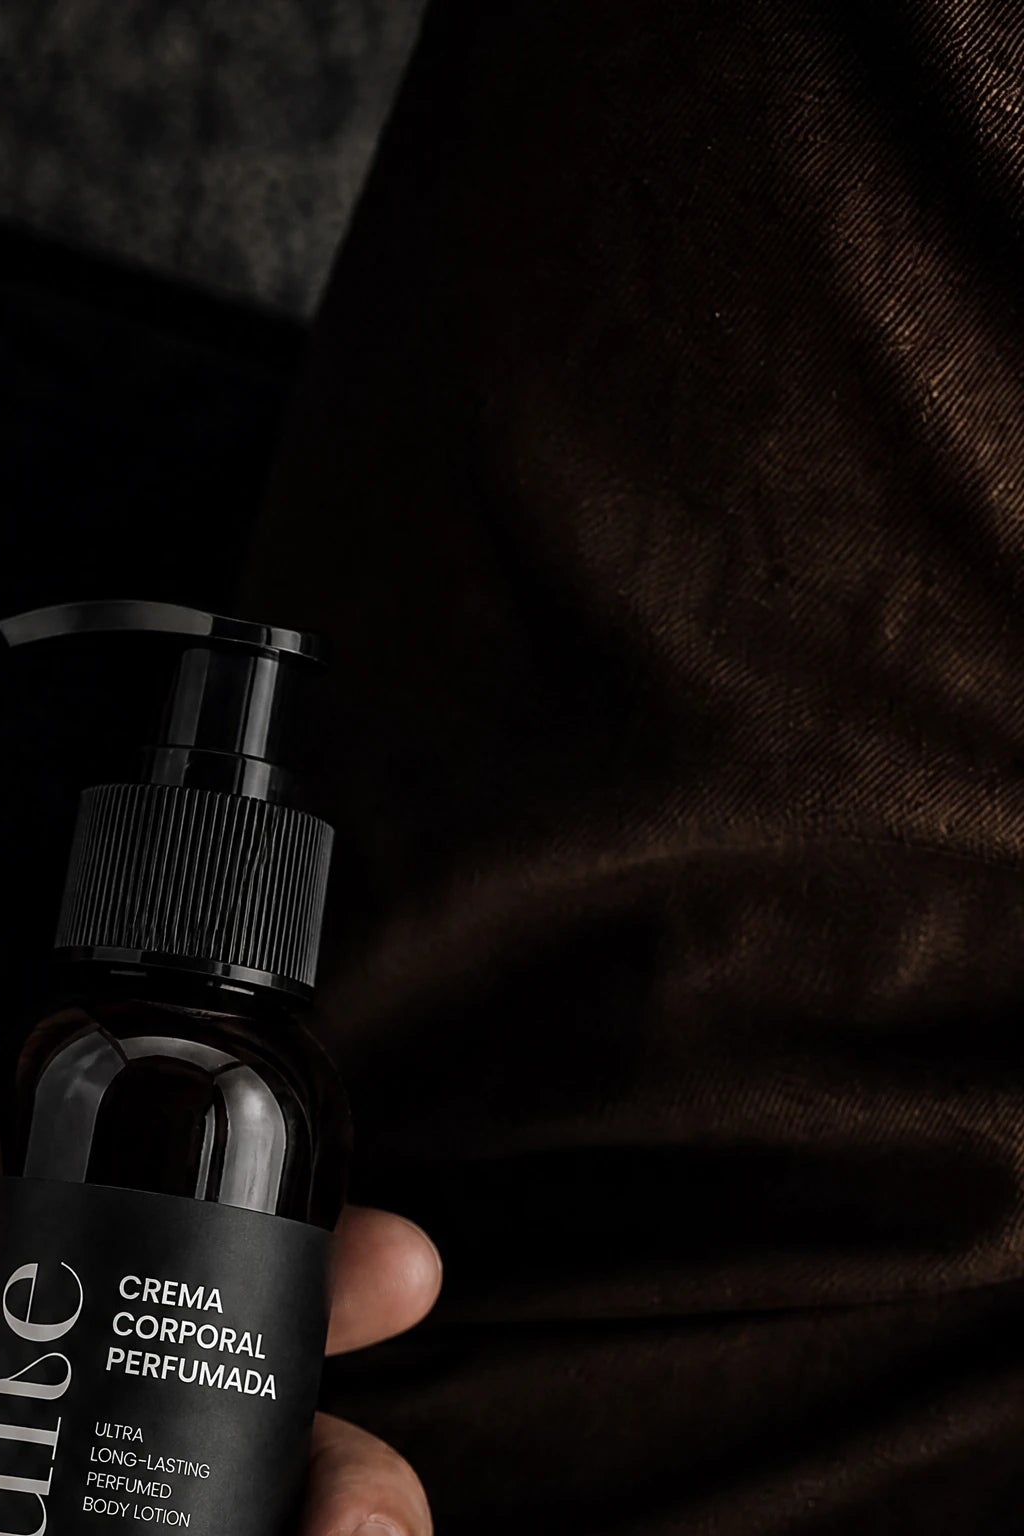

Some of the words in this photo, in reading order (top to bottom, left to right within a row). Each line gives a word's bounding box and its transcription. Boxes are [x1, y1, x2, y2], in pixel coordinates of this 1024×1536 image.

[118, 1275, 224, 1313] CREMA
[112, 1311, 266, 1359] CORPORAL
[105, 1346, 277, 1400] PERFUMADA
[94, 1421, 144, 1443] ULTRA
[90, 1446, 210, 1479] LONG-LASTING
[86, 1471, 172, 1499] PERFUMED
[82, 1496, 129, 1517] BODY
[133, 1506, 191, 1528] LOTION
